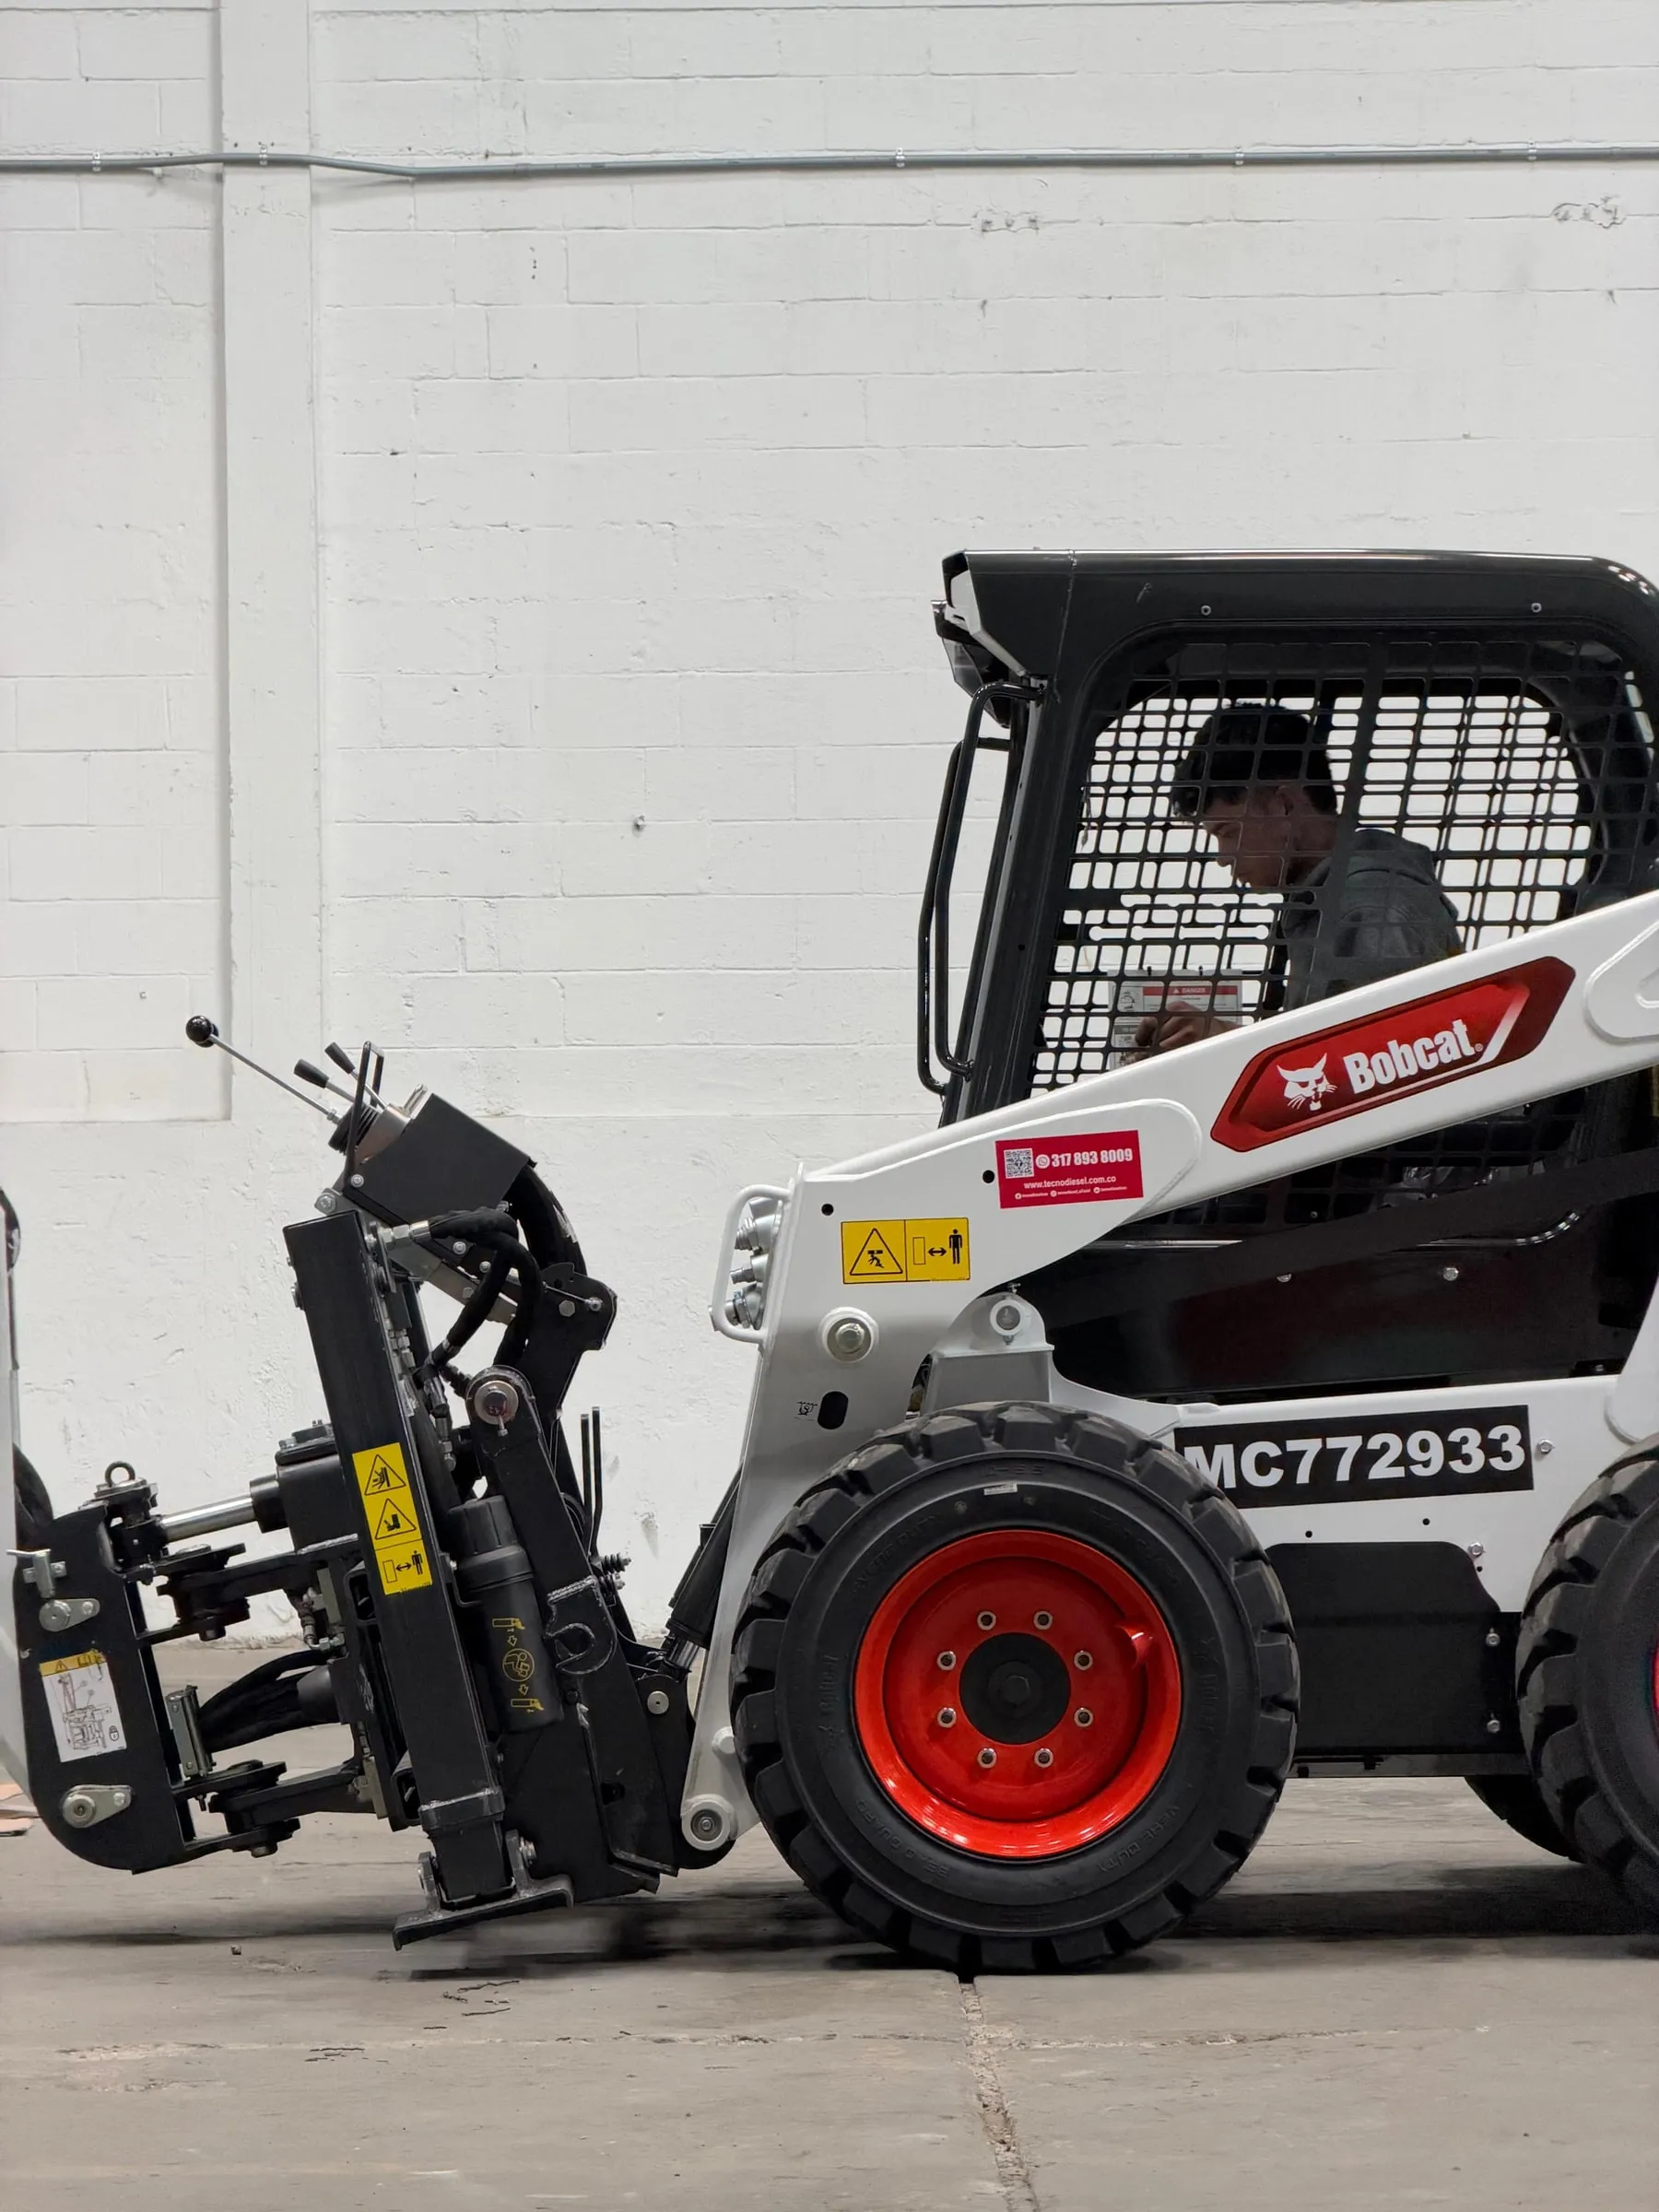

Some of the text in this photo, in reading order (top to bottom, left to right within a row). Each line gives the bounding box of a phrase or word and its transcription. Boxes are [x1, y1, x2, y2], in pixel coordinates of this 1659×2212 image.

[1343, 1018, 1475, 1094] Bobcat
[1051, 1148, 1133, 1168] 317 893 8009
[1024, 1176, 1116, 1189] www.tecnodiesel.com.co
[1183, 1424, 1525, 1489] MC772933
